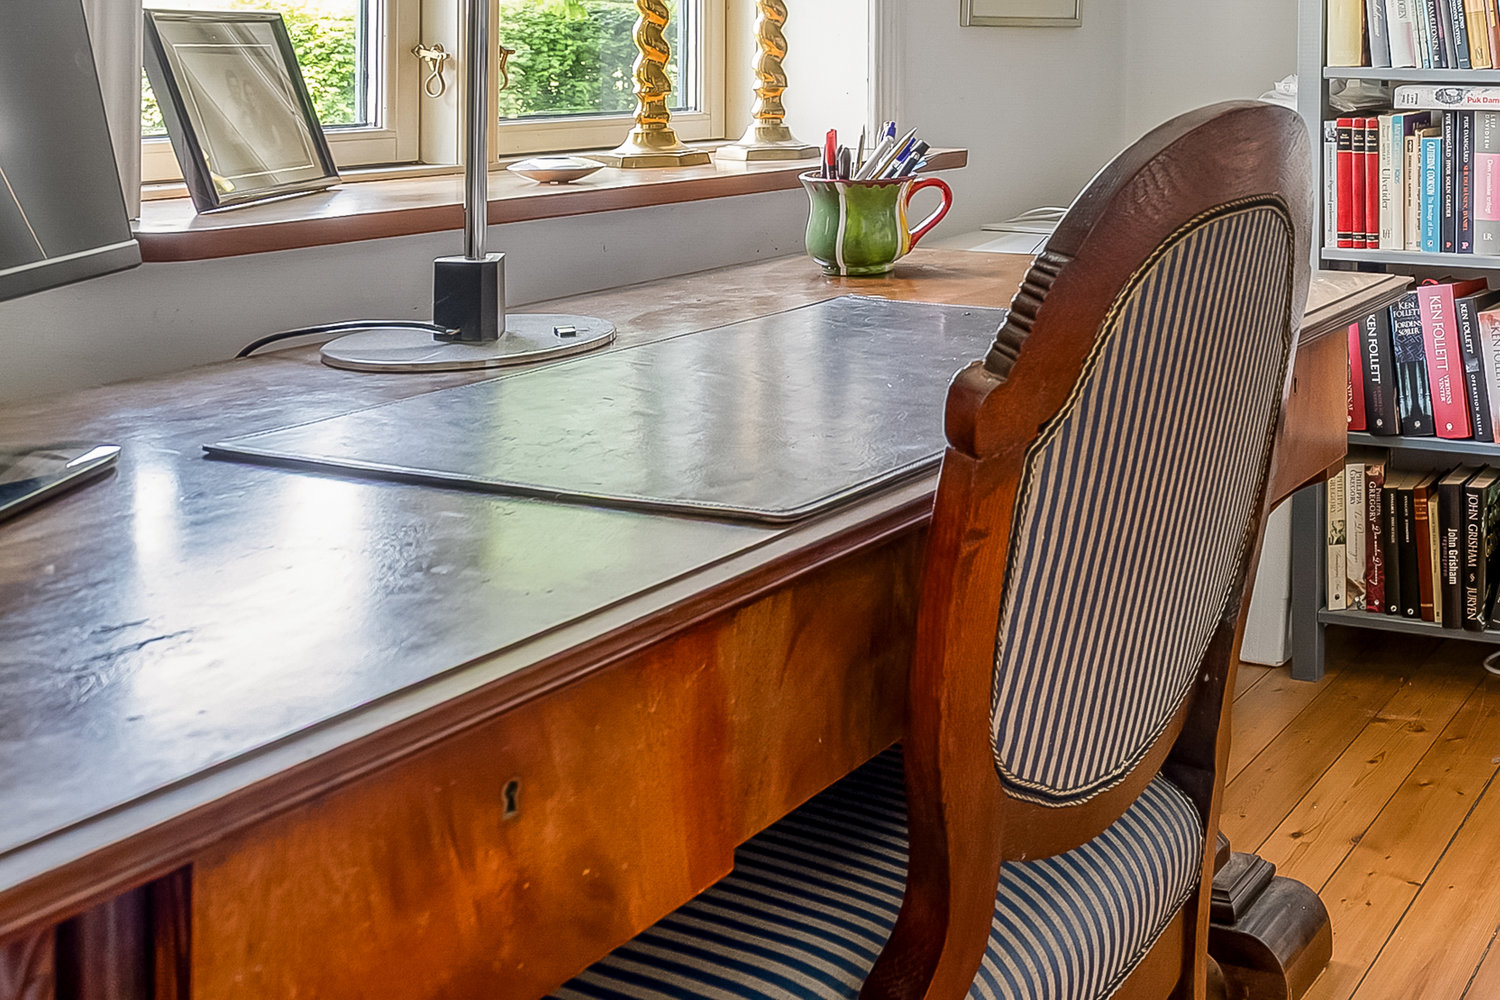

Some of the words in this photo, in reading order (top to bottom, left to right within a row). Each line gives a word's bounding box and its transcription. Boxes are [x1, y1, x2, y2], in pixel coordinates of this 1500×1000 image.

[1381, 168, 1390, 210] Ulvetider
[1393, 309, 1420, 317] FOLLETT
[1398, 301, 1415, 310] KEN
[1429, 295, 1441, 319] KEN
[1366, 314, 1376, 336] KEN
[1395, 321, 1422, 332] JORDENS
[1432, 323, 1449, 371] FOLLETT
[1368, 339, 1381, 384] FOLLETT
[1443, 375, 1452, 404] VERDENS
[1466, 493, 1478, 520] JOHN
[1448, 528, 1457, 547] John
[1467, 524, 1478, 567] GRISHAM
[1449, 550, 1458, 584] Grisham
[1466, 587, 1477, 620] JURYEN
